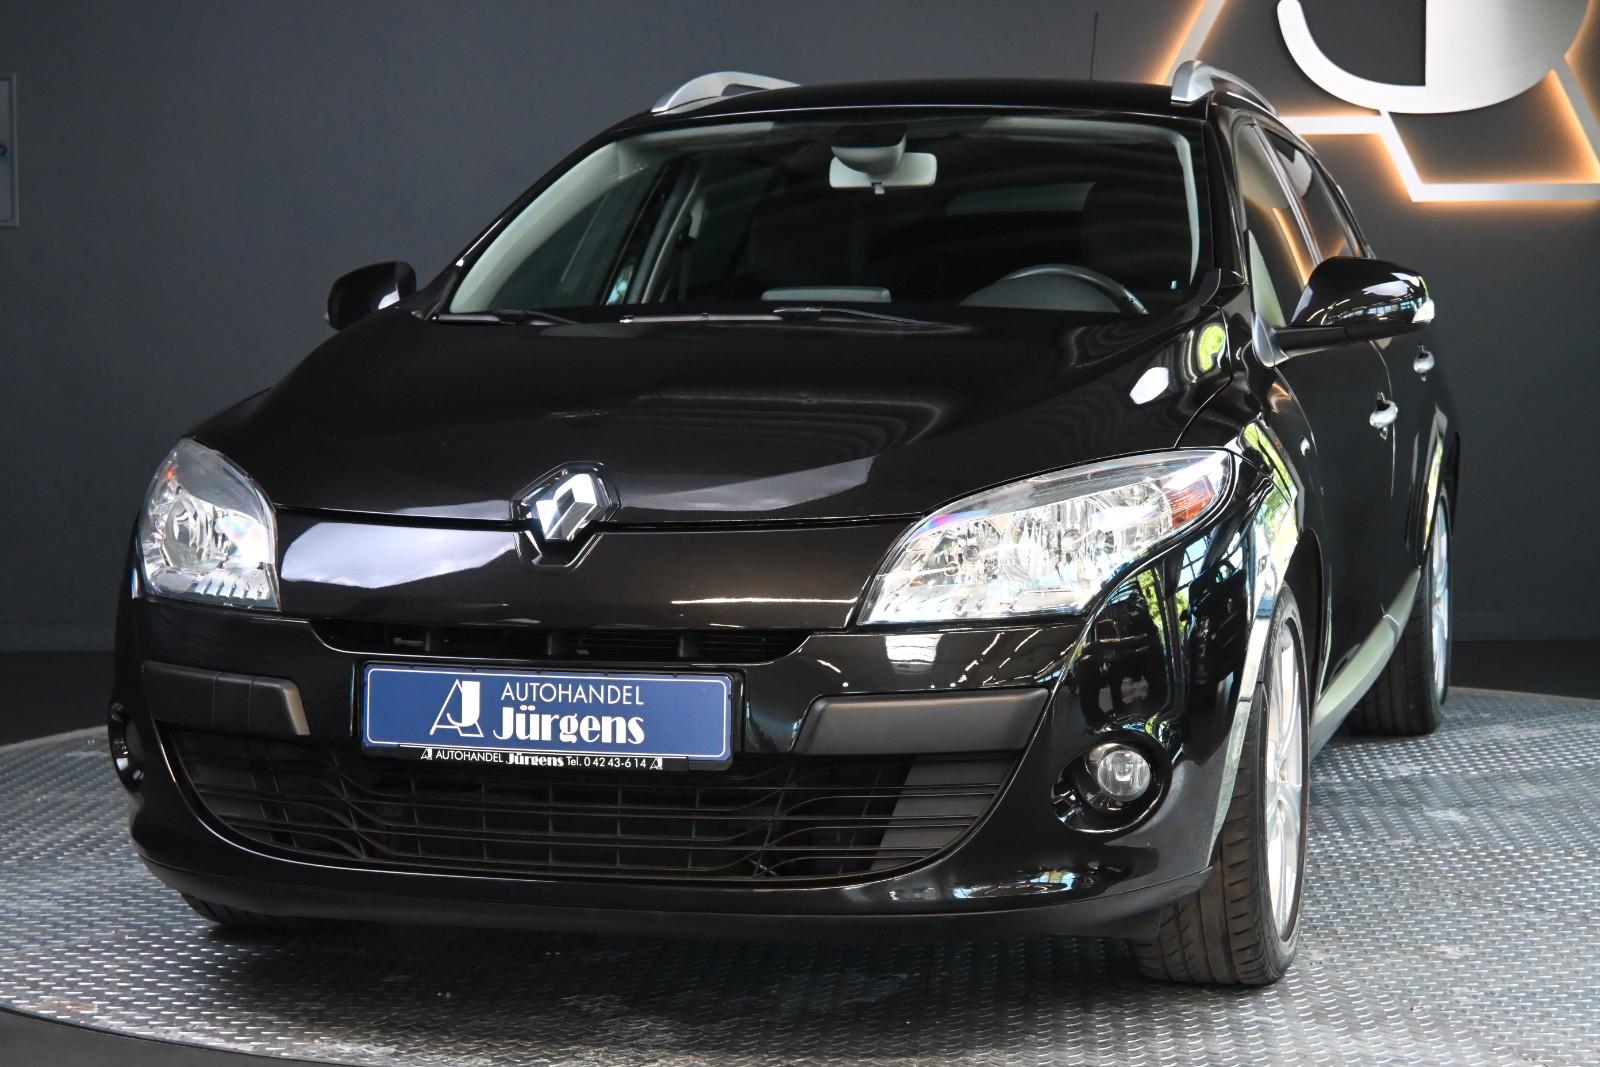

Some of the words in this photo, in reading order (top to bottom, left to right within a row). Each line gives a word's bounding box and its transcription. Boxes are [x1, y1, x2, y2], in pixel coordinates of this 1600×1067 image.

[500, 682, 645, 706] AUTOHANDEL
[492, 704, 646, 745] Jürgens
[435, 750, 504, 763] AUTOHANDEL
[505, 752, 564, 766] Jürgens
[566, 755, 582, 767] Tel.
